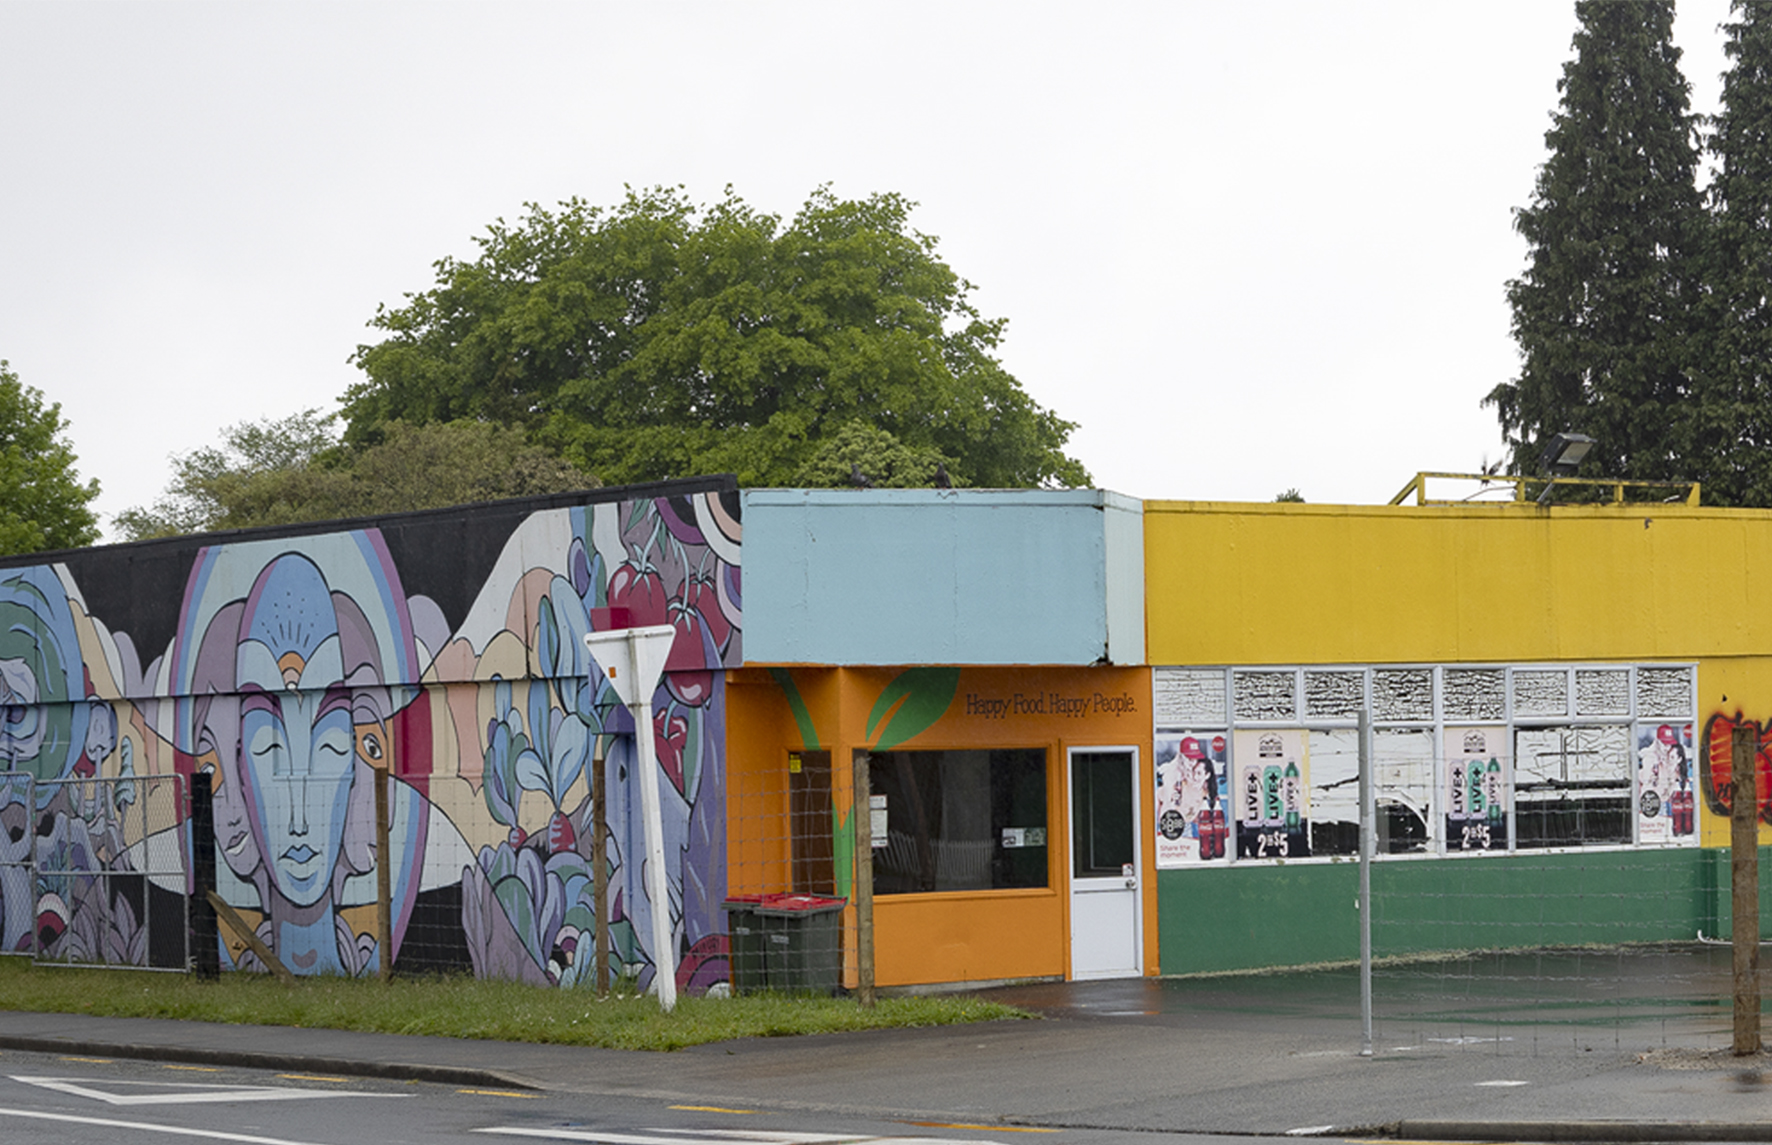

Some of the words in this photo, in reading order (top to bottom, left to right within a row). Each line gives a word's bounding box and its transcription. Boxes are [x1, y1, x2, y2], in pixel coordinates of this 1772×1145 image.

[966, 694, 1010, 719] Happy
[1013, 691, 1047, 714] Food.
[1049, 693, 1090, 718] Happy
[1093, 692, 1138, 717] People.
[1248, 772, 1258, 820] LIVE+
[1269, 772, 1279, 820] LIVE+
[1453, 767, 1463, 814] LIVE+
[1473, 767, 1482, 814] LIVE+
